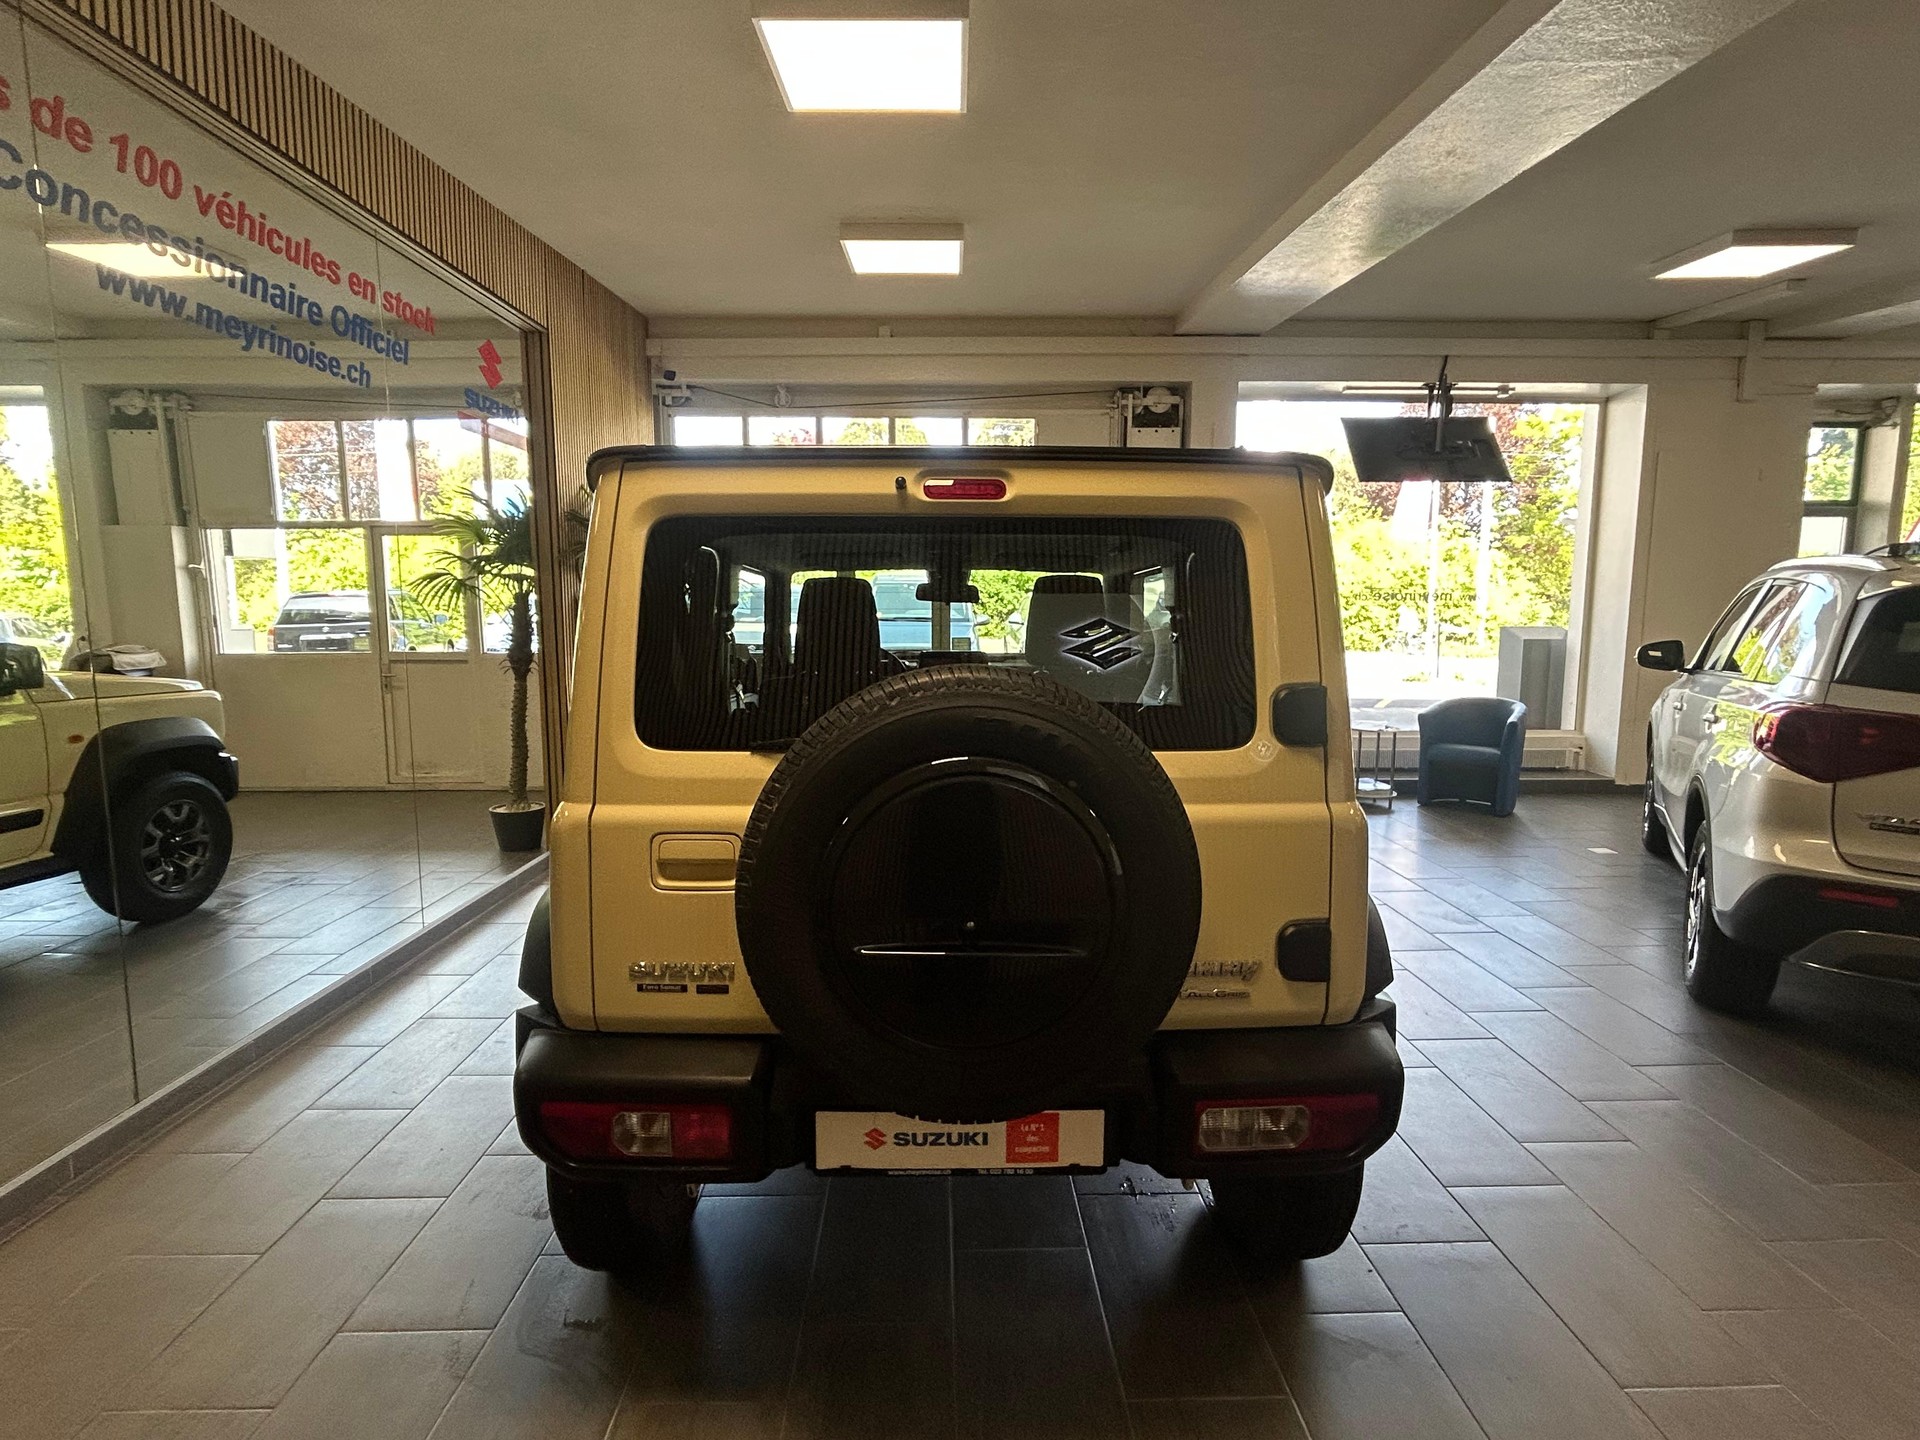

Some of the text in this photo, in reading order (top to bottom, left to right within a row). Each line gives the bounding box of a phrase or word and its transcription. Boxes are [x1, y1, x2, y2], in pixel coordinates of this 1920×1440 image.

[0, 138, 410, 365] Concessionnaire Officiel
[31, 95, 438, 336] de 100 véhicules en stock
[95, 262, 371, 388] www.meyrinoise.ch
[628, 961, 736, 983] SUZUKI
[893, 1131, 989, 1147] SUZUKI
